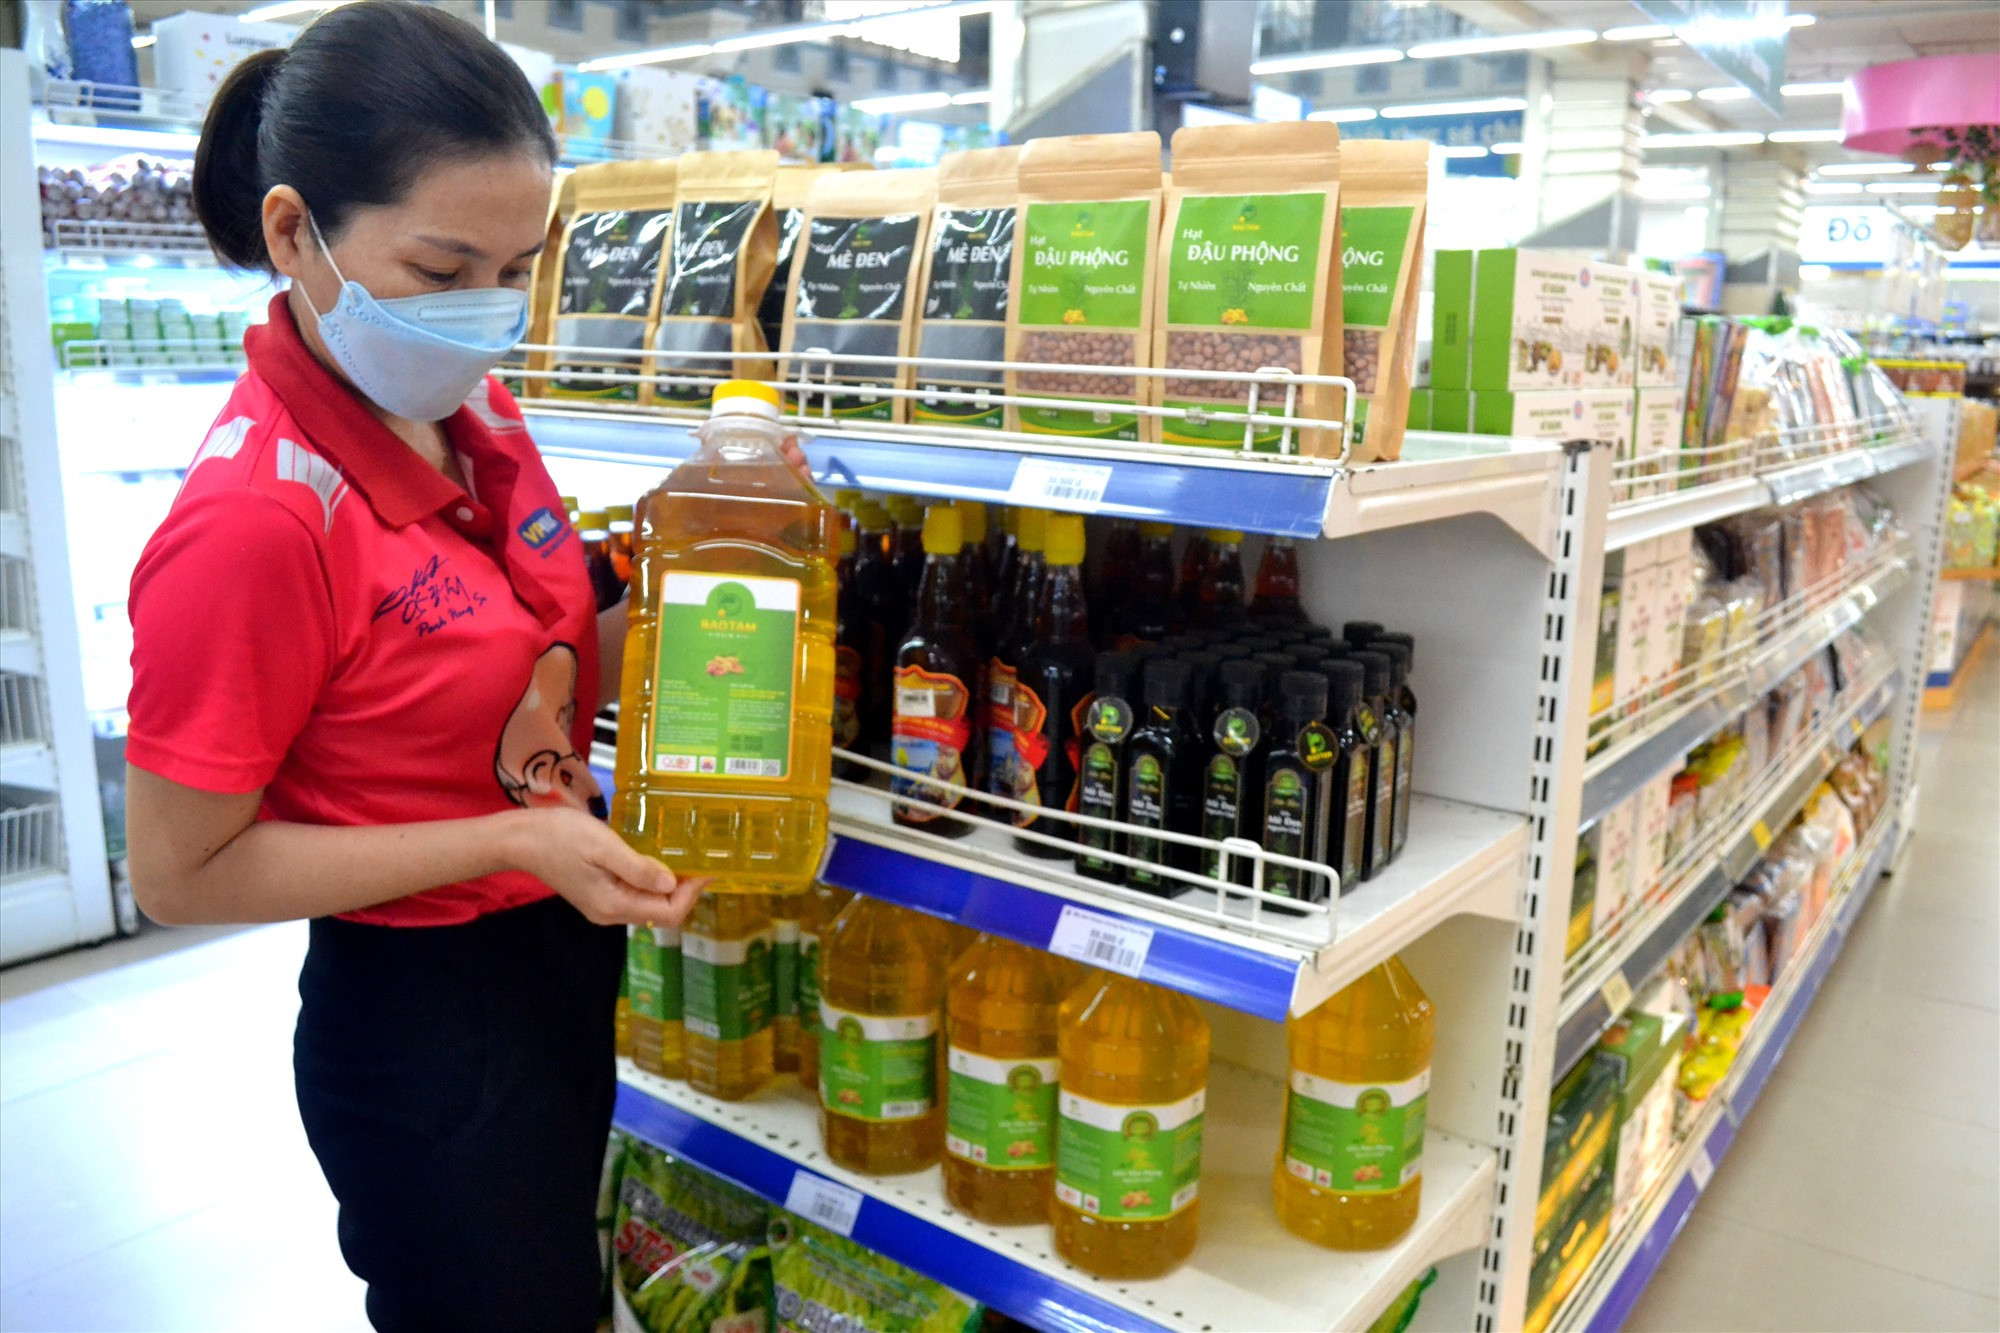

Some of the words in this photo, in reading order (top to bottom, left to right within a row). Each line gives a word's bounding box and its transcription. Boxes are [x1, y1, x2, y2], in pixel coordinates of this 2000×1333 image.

[1183, 228, 1203, 241] Hạt
[608, 245, 643, 263] ĐEN
[826, 249, 851, 269] MÈ
[854, 251, 890, 268] ĐEN
[946, 242, 968, 263] MÈ
[1034, 246, 1067, 270] ĐẬU
[1069, 246, 1129, 270] PHỘNG
[1187, 241, 1227, 265] ĐẬU
[1230, 241, 1300, 266] PHỘNG
[1341, 247, 1385, 268] ỘNG
[1190, 280, 1217, 292] Nhiên
[1247, 281, 1282, 294] Nguyên
[1284, 280, 1307, 293] Chất
